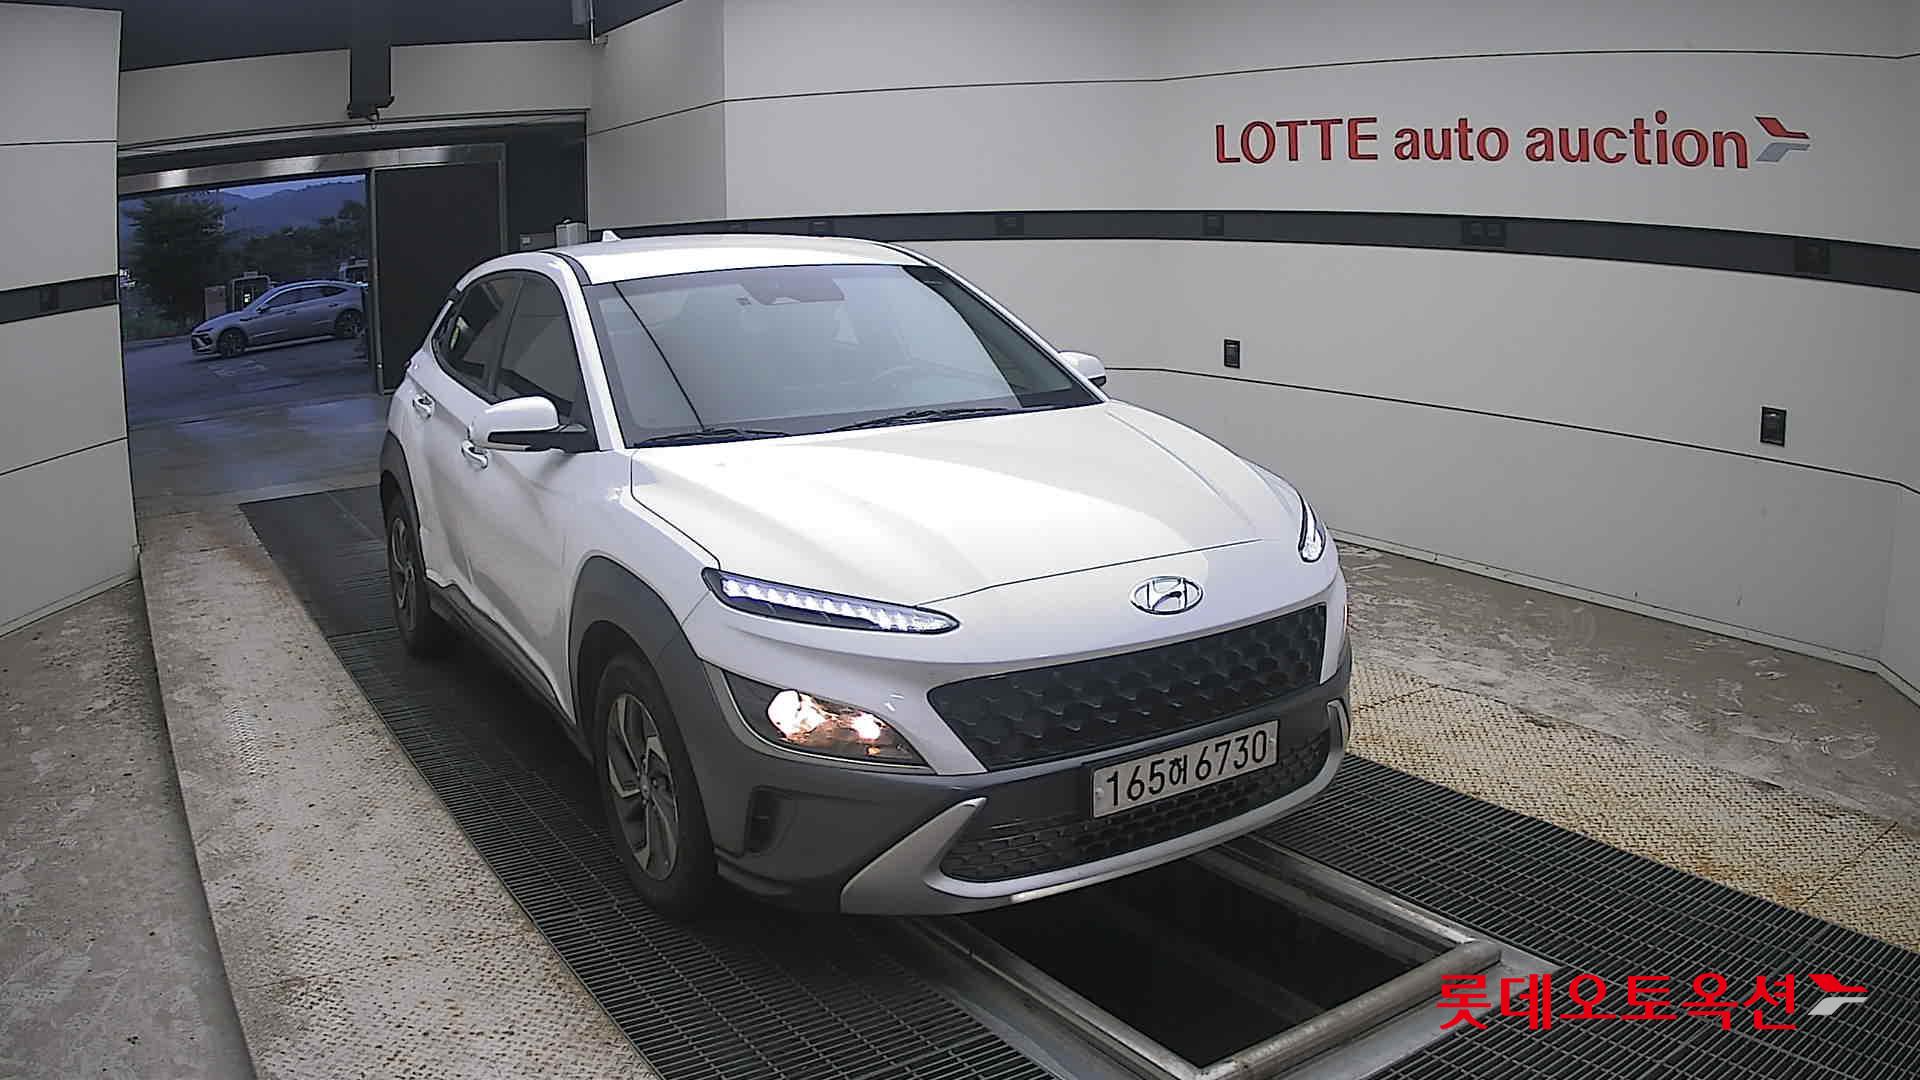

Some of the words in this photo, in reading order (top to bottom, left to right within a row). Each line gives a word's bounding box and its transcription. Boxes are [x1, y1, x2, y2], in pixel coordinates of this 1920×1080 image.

[1215, 117, 1378, 164] LOTTE
[1393, 117, 1509, 162] auto
[1525, 110, 1749, 169] auction
